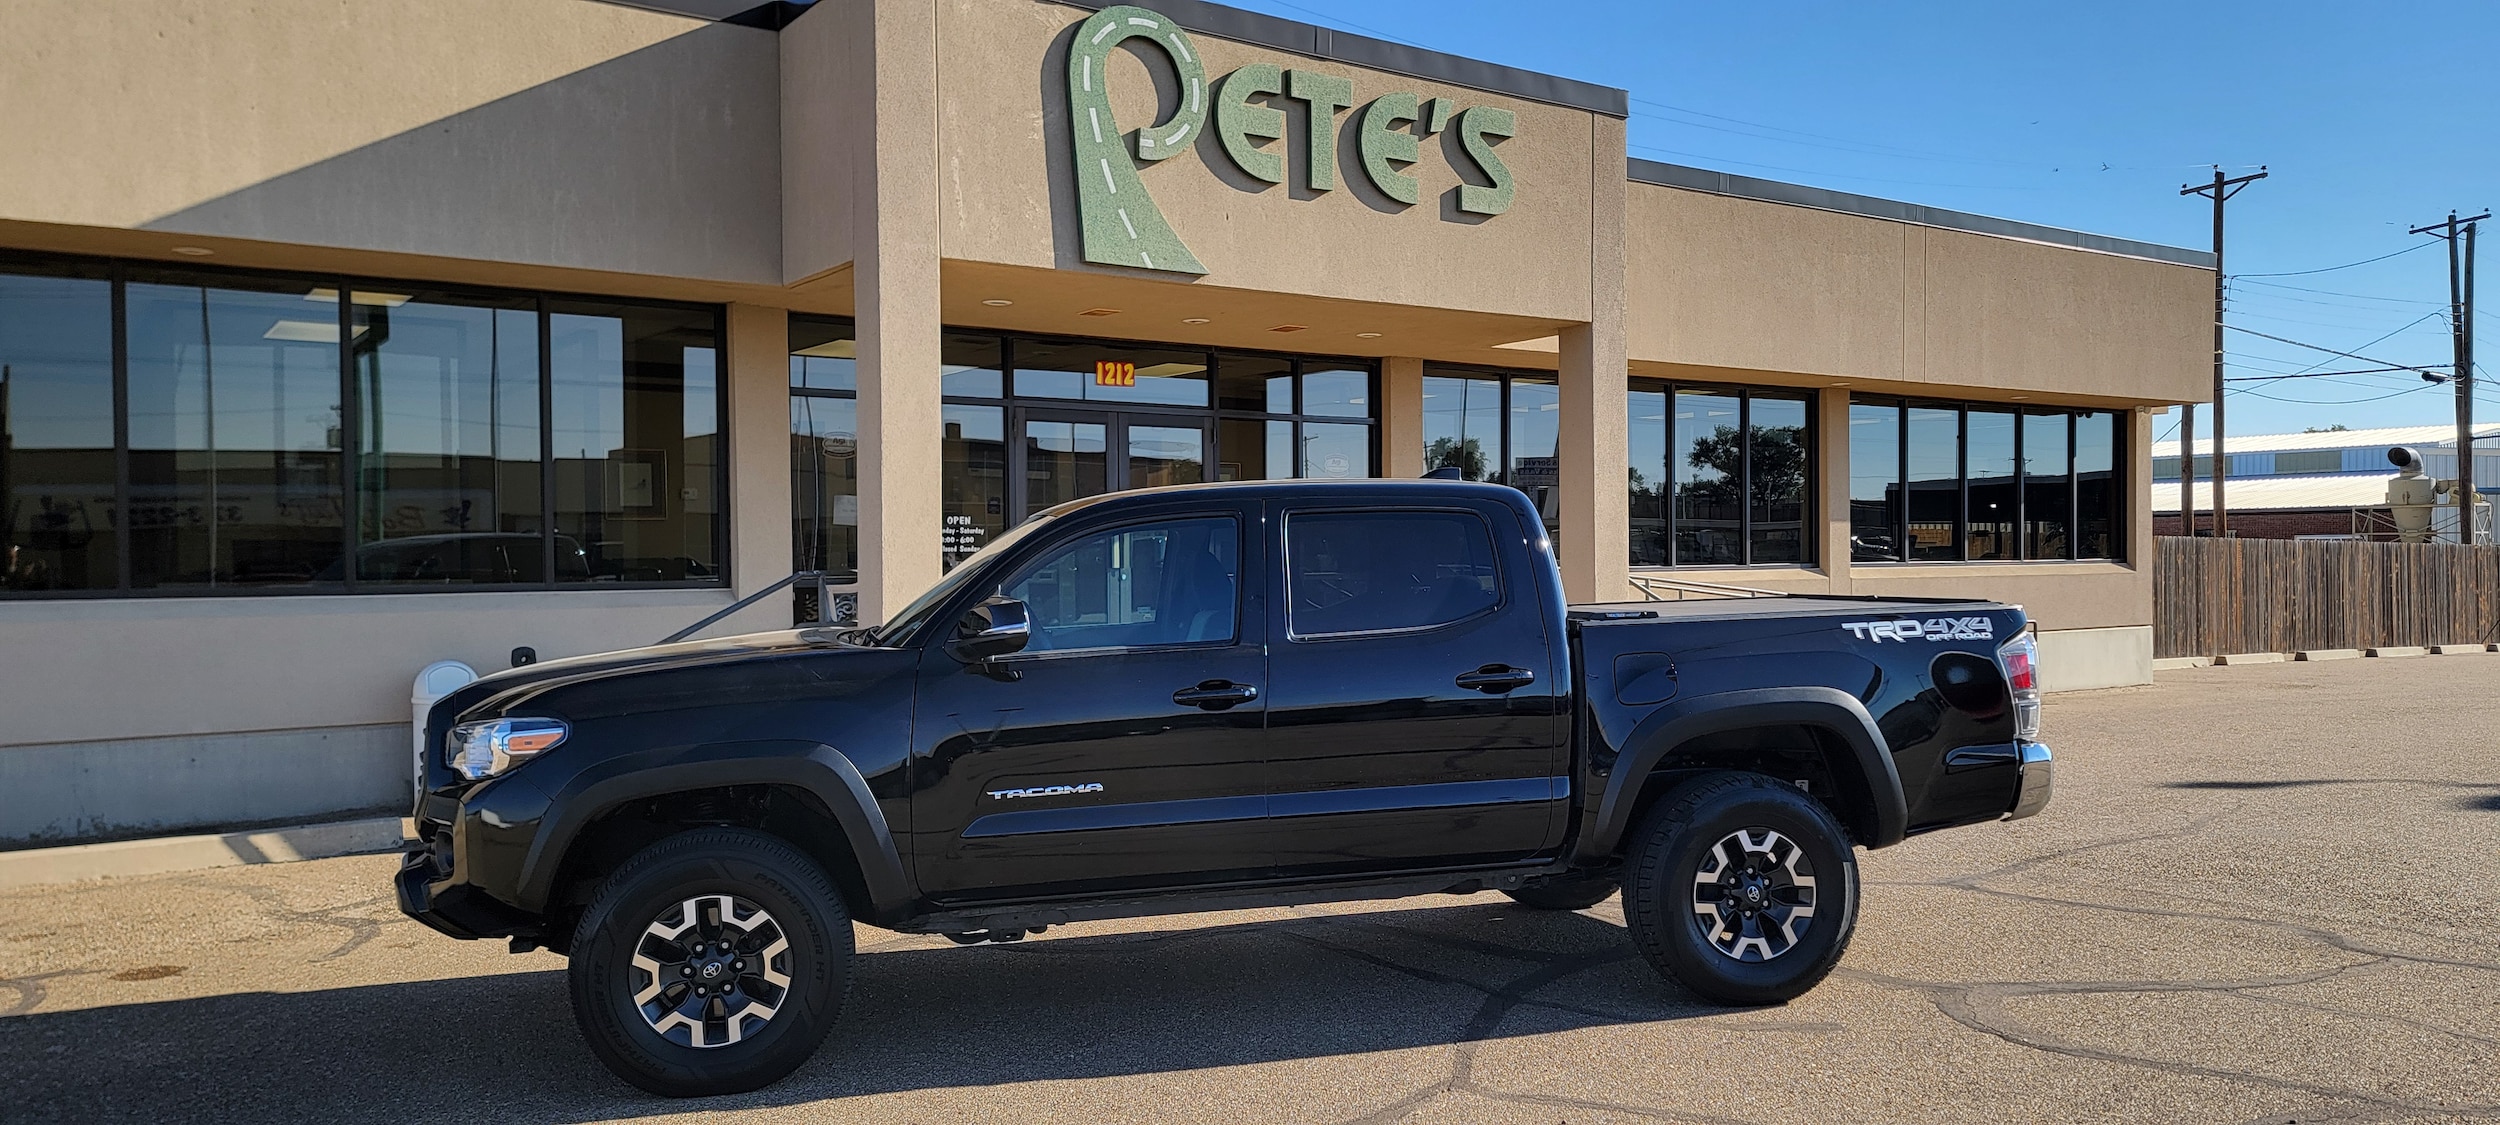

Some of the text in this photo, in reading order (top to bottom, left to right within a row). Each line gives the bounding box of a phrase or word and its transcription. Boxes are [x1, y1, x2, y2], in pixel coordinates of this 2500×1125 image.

[1069, 4, 1516, 275] PETE'S
[1096, 361, 1134, 386] 1212
[947, 516, 971, 525] OPEN
[960, 527, 984, 535] Saturday
[1925, 631, 1994, 641] OFF ROAD
[986, 782, 1104, 800] TACOMA
[752, 871, 825, 956] PATHFINDER
